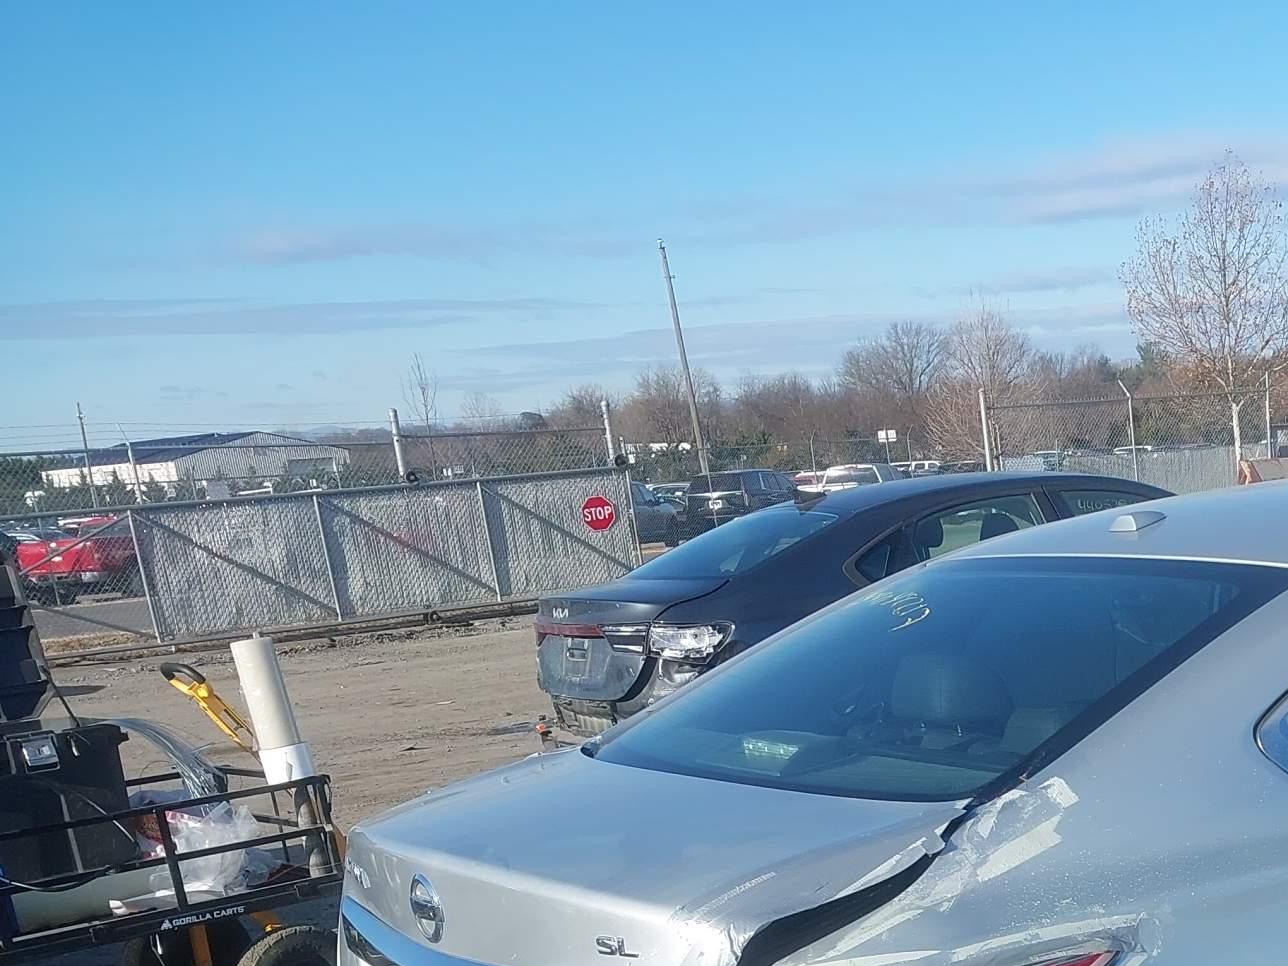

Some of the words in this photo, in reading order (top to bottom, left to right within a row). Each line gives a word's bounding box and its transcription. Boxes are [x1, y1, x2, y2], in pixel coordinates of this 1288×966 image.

[583, 505, 612, 521] STOP
[172, 912, 213, 927] GORILLA
[213, 905, 246, 919] CARTS
[595, 935, 640, 959] SL
